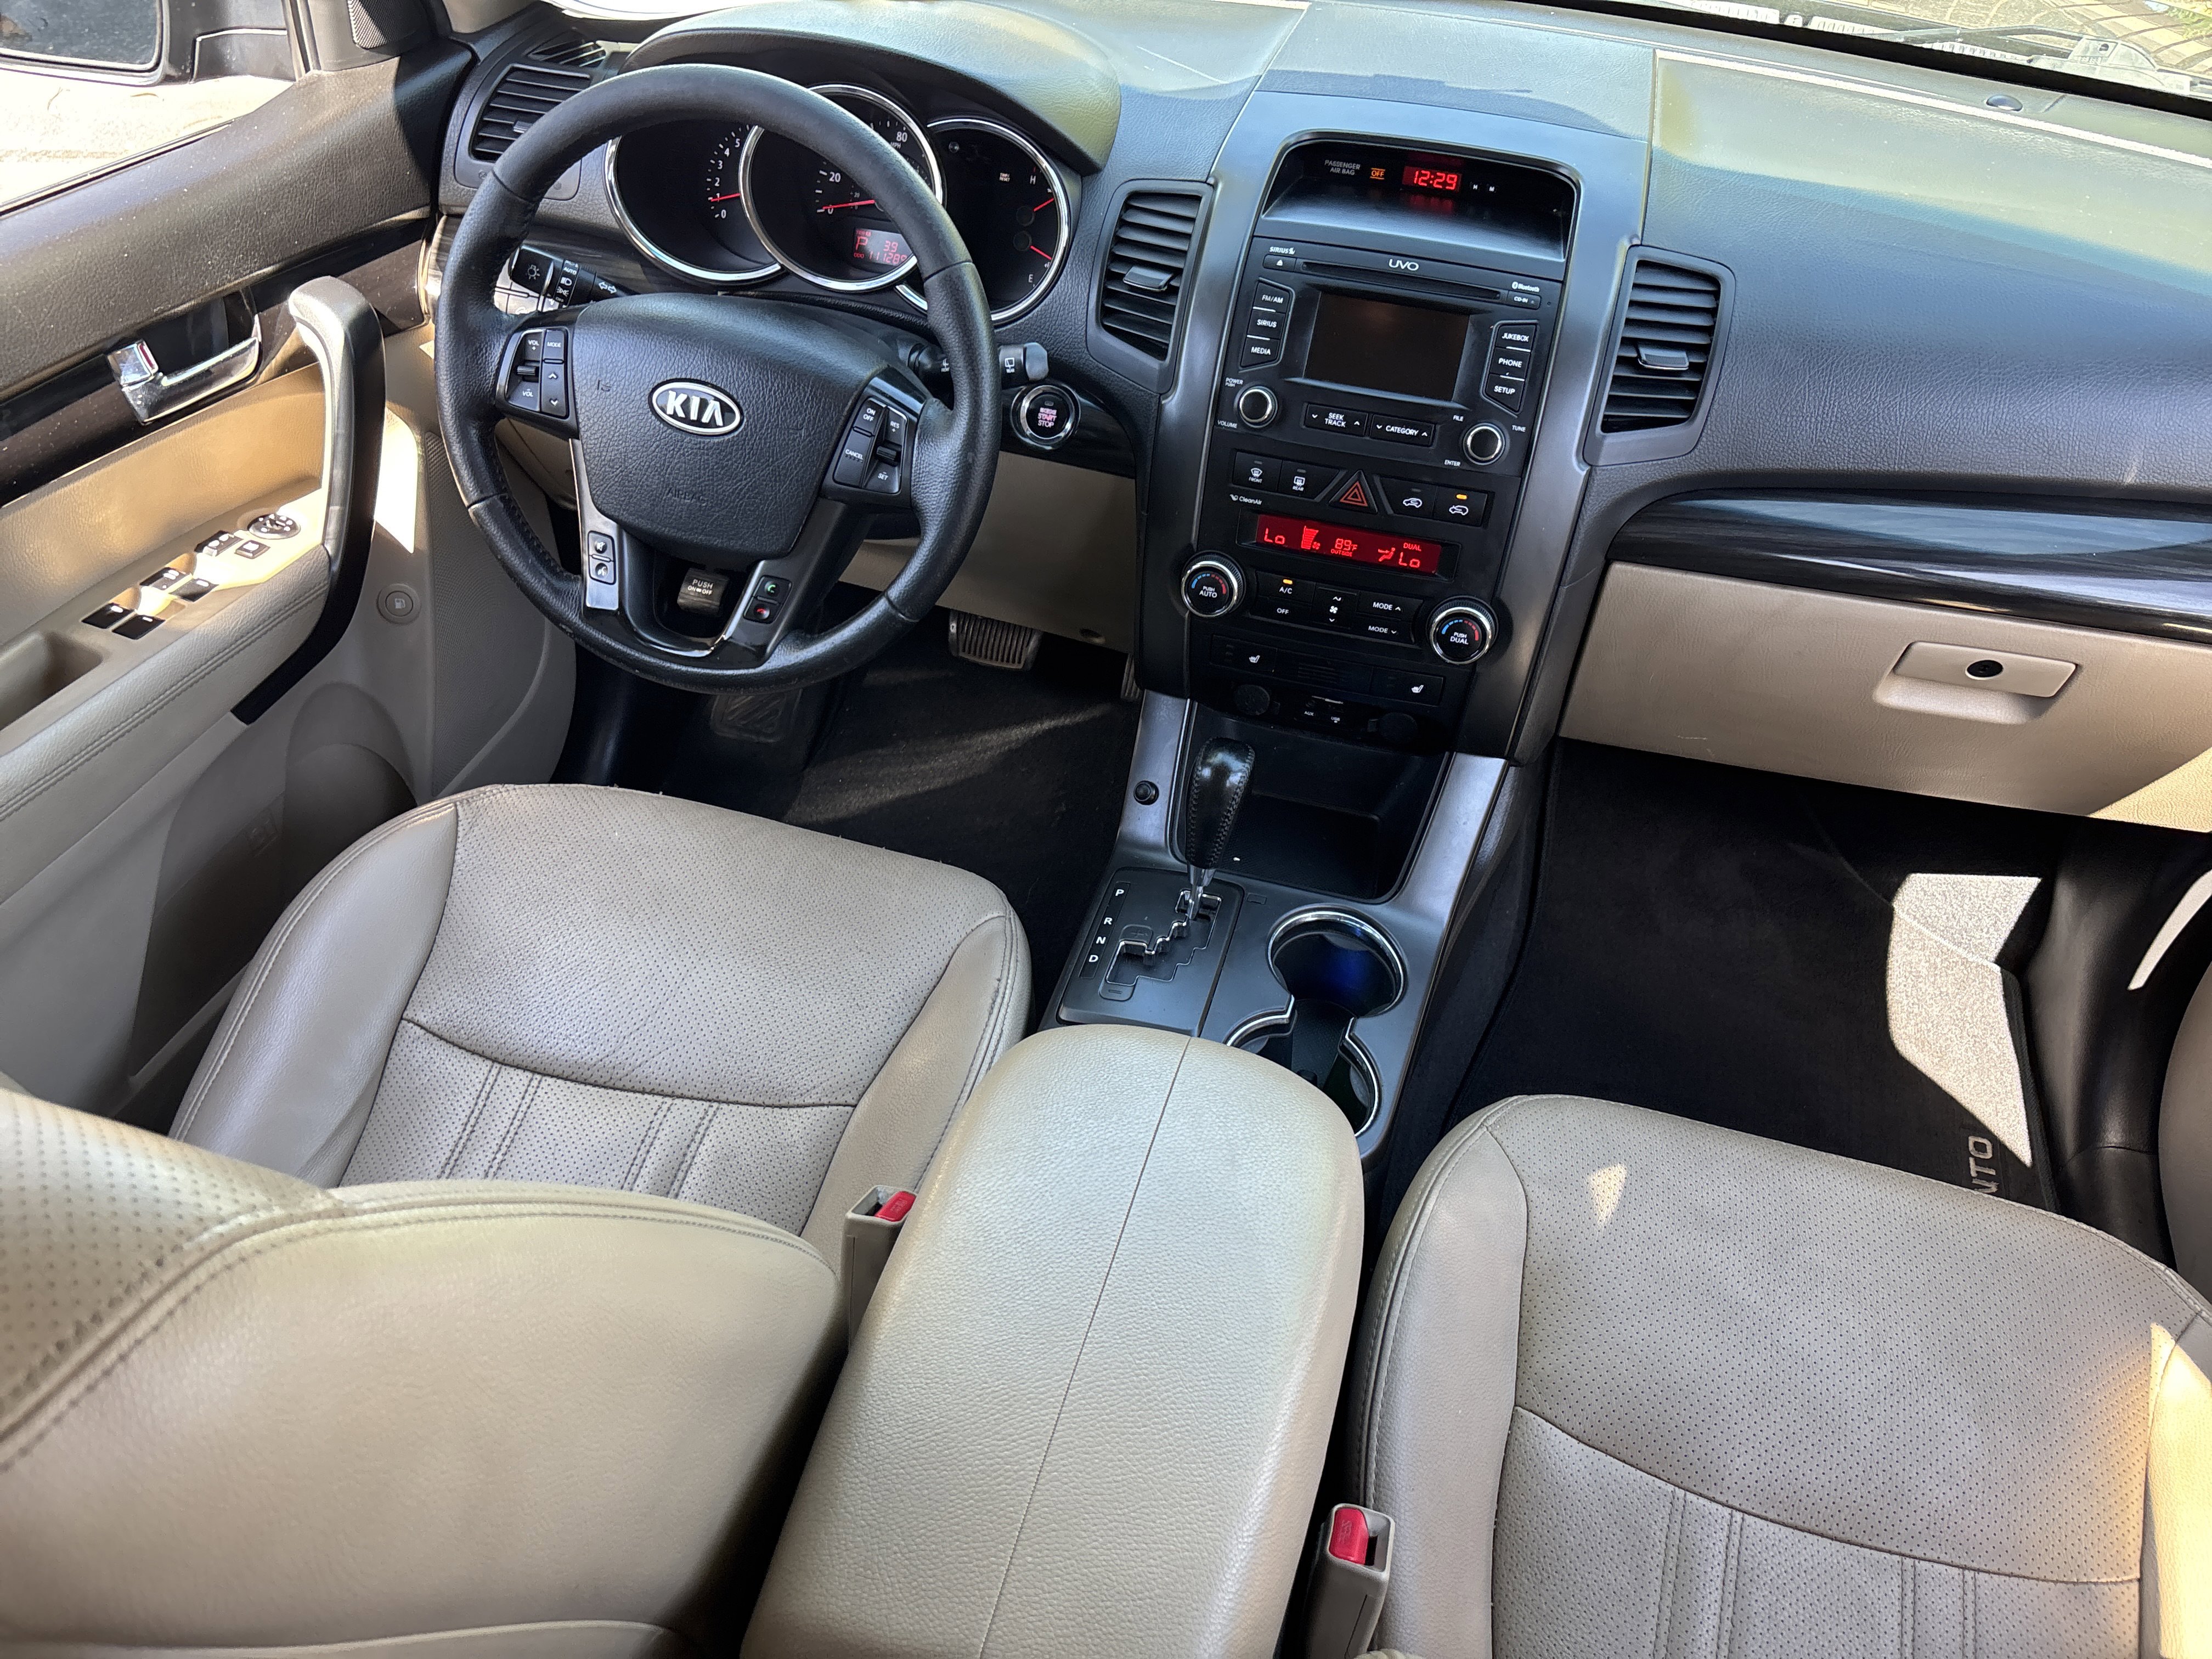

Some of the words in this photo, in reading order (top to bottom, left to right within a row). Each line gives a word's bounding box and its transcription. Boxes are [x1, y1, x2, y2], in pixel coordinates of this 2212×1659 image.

[896, 132, 907, 142] 80
[735, 138, 741, 148] 5
[724, 148, 730, 157] 4
[718, 160, 723, 170] 3
[1324, 160, 1361, 170] PASSENGER
[829, 171, 841, 183] 20
[1030, 175, 1036, 185] H
[1414, 170, 1458, 190] 12:29
[714, 177, 720, 187] 2
[716, 193, 720, 202] 1
[828, 204, 834, 214] 0
[721, 209, 726, 219] 0
[856, 236, 868, 250] P
[883, 240, 898, 252] 3.9
[1389, 258, 1419, 271] UVO
[563, 266, 577, 275] AUTO
[1029, 274, 1034, 283] E
[1518, 284, 1540, 292] Bluetooth
[1262, 295, 1283, 303] FM/AM
[1257, 319, 1277, 328] SIRIUS
[1502, 333, 1529, 342] JUKEBOX
[1251, 347, 1271, 355] MEDIA
[1498, 358, 1522, 368] PHONE
[1494, 386, 1515, 394] SETUP
[667, 390, 723, 426] KIA
[863, 414, 874, 422] OFF
[1038, 413, 1057, 421] START
[1328, 413, 1344, 421] SEEK
[890, 421, 900, 429] RES
[1038, 420, 1054, 428] STOP
[1217, 420, 1237, 428] VOLUME
[1324, 418, 1346, 427] TRACK
[1386, 426, 1419, 436] CATEGORY
[845, 449, 864, 460] CANCEL
[1239, 496, 1262, 505] CleanAir
[1264, 528, 1285, 545] Lo
[1403, 542, 1421, 551] DUAL
[1330, 549, 1352, 557] OUTSIDE
[1398, 552, 1420, 568] Lo
[692, 579, 713, 589] PUSH
[1199, 590, 1217, 598] AUTO
[1373, 601, 1393, 611] MODE
[1368, 625, 1389, 634] MODE
[1450, 636, 1469, 645] DUAL
